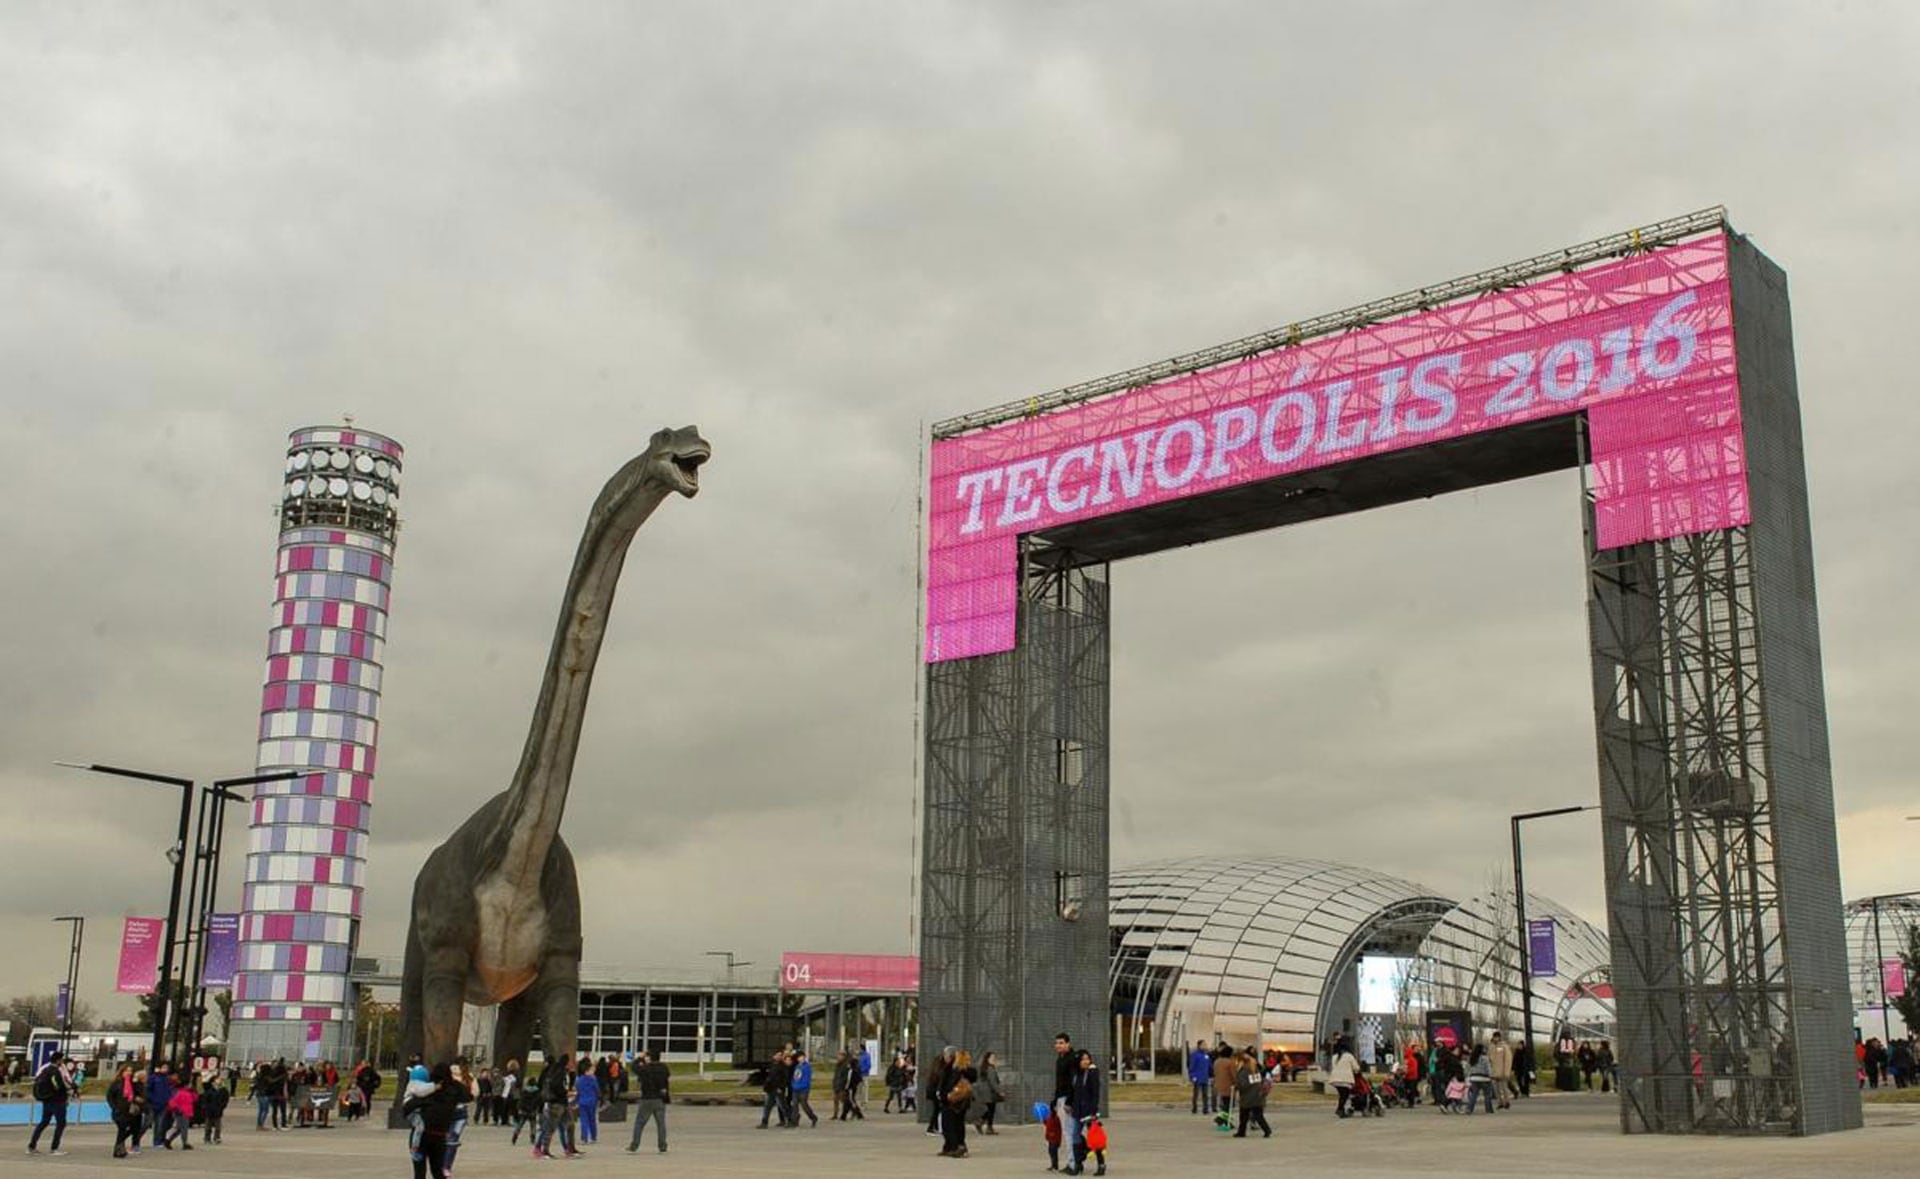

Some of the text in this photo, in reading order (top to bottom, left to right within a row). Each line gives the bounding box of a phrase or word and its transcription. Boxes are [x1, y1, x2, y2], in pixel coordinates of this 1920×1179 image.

[956, 290, 1700, 535] TECNOPÓLIS 2016
[786, 963, 811, 982] 04
